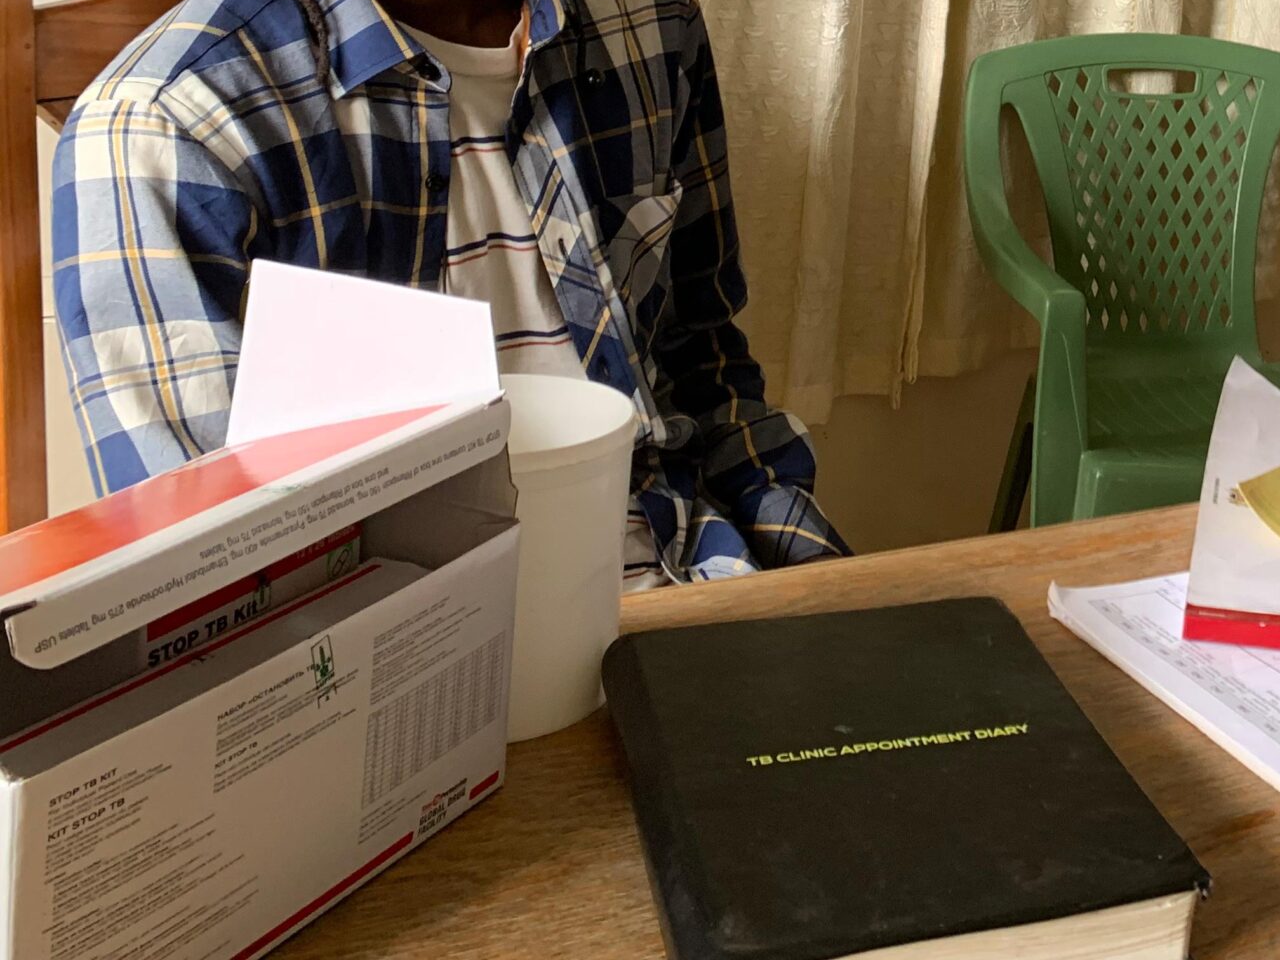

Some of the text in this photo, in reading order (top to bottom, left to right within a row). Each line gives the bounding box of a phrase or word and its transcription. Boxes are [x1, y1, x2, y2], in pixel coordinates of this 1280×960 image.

[148, 598, 259, 668] STOP TB Kit
[747, 723, 1029, 767] TB CLINIC APPOINTMENT DIARY
[49, 767, 118, 807] STOP TB KIT
[47, 797, 126, 842] KIT STOP TB
